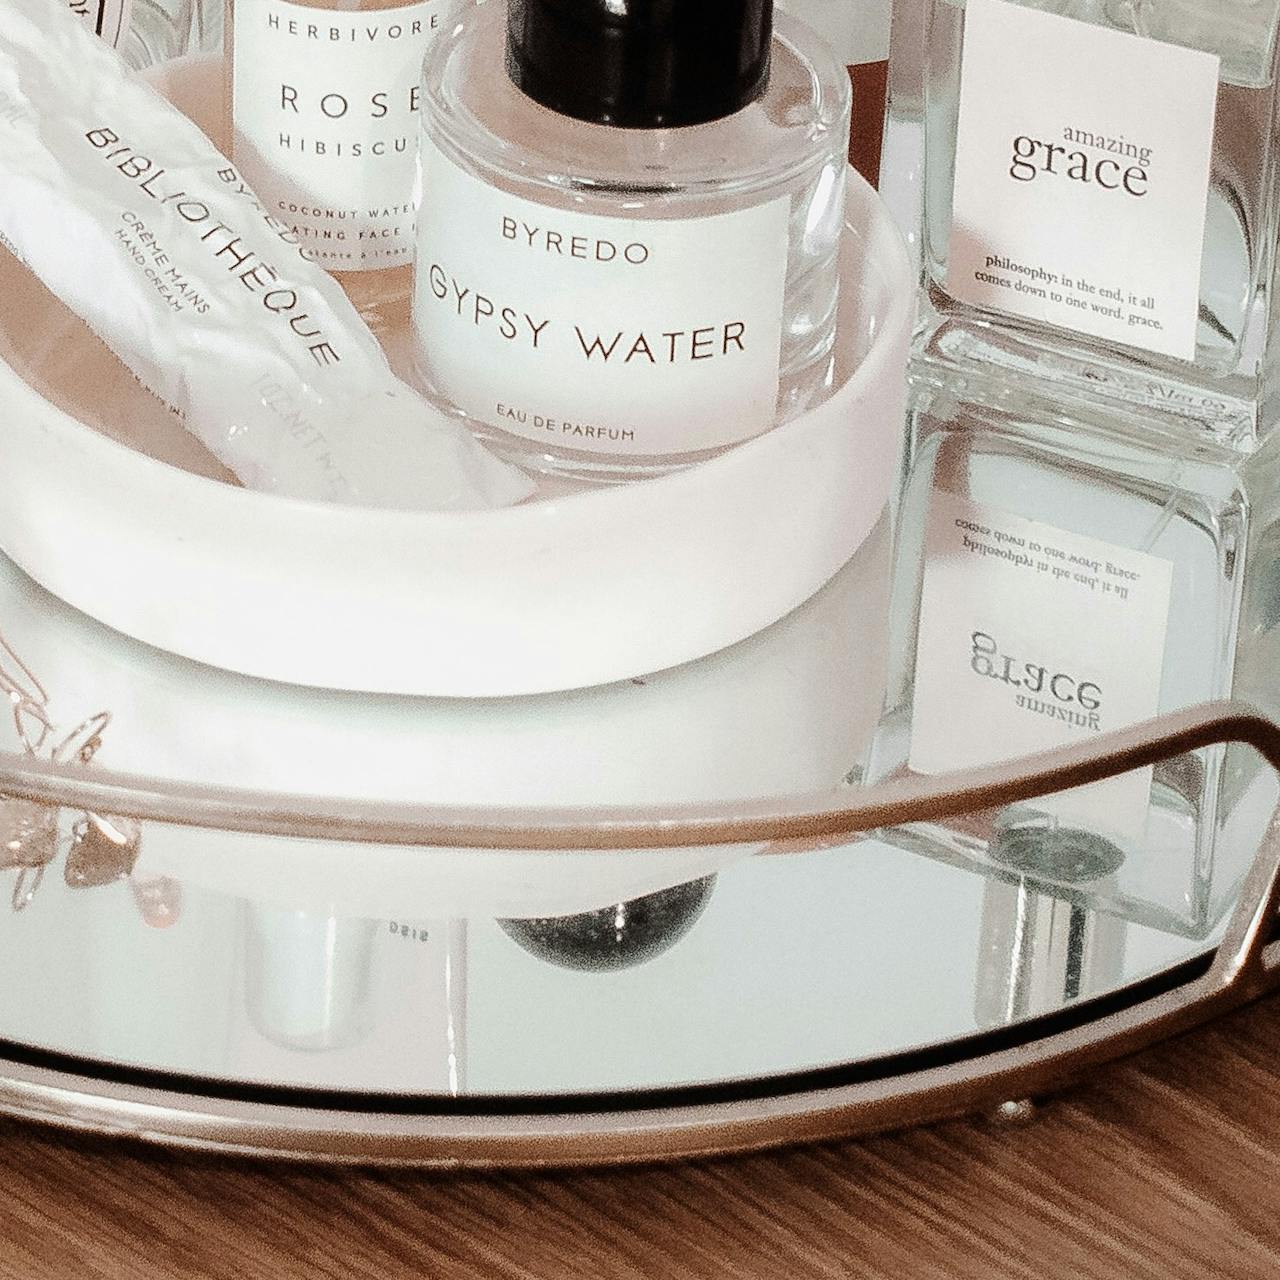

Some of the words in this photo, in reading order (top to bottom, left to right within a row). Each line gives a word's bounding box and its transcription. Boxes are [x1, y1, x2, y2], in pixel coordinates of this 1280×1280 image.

[268, 14, 440, 41] HERBIVORE
[281, 84, 420, 118] ROSE
[279, 132, 418, 157] HIBISCU
[1009, 135, 1149, 197] grace
[1063, 126, 1153, 167] amazing
[217, 168, 316, 262] BYED
[278, 201, 358, 219] COCONUT
[368, 202, 416, 218] WATE
[283, 222, 346, 240] ATING
[359, 227, 400, 241] FACE
[502, 216, 650, 264] BYREDO
[114, 228, 146, 266] HAND
[144, 268, 183, 312] CREAM
[165, 267, 210, 313] MAINS
[985, 255, 1058, 284] philosophy:
[1061, 274, 1074, 288] in
[1076, 278, 1096, 294] the
[1099, 288, 1124, 303] end,
[1128, 293, 1138, 305] it
[1140, 297, 1155, 310] all
[429, 264, 550, 349] GYPSY
[574, 321, 747, 364] WATER
[974, 270, 1012, 288] comes
[1014, 280, 1047, 298] down
[1050, 291, 1063, 303] to
[1065, 295, 1088, 310] one
[1128, 313, 1164, 330] grace.
[496, 403, 527, 424] EAU
[533, 415, 556, 431] DE
[562, 422, 635, 440] PARFUM
